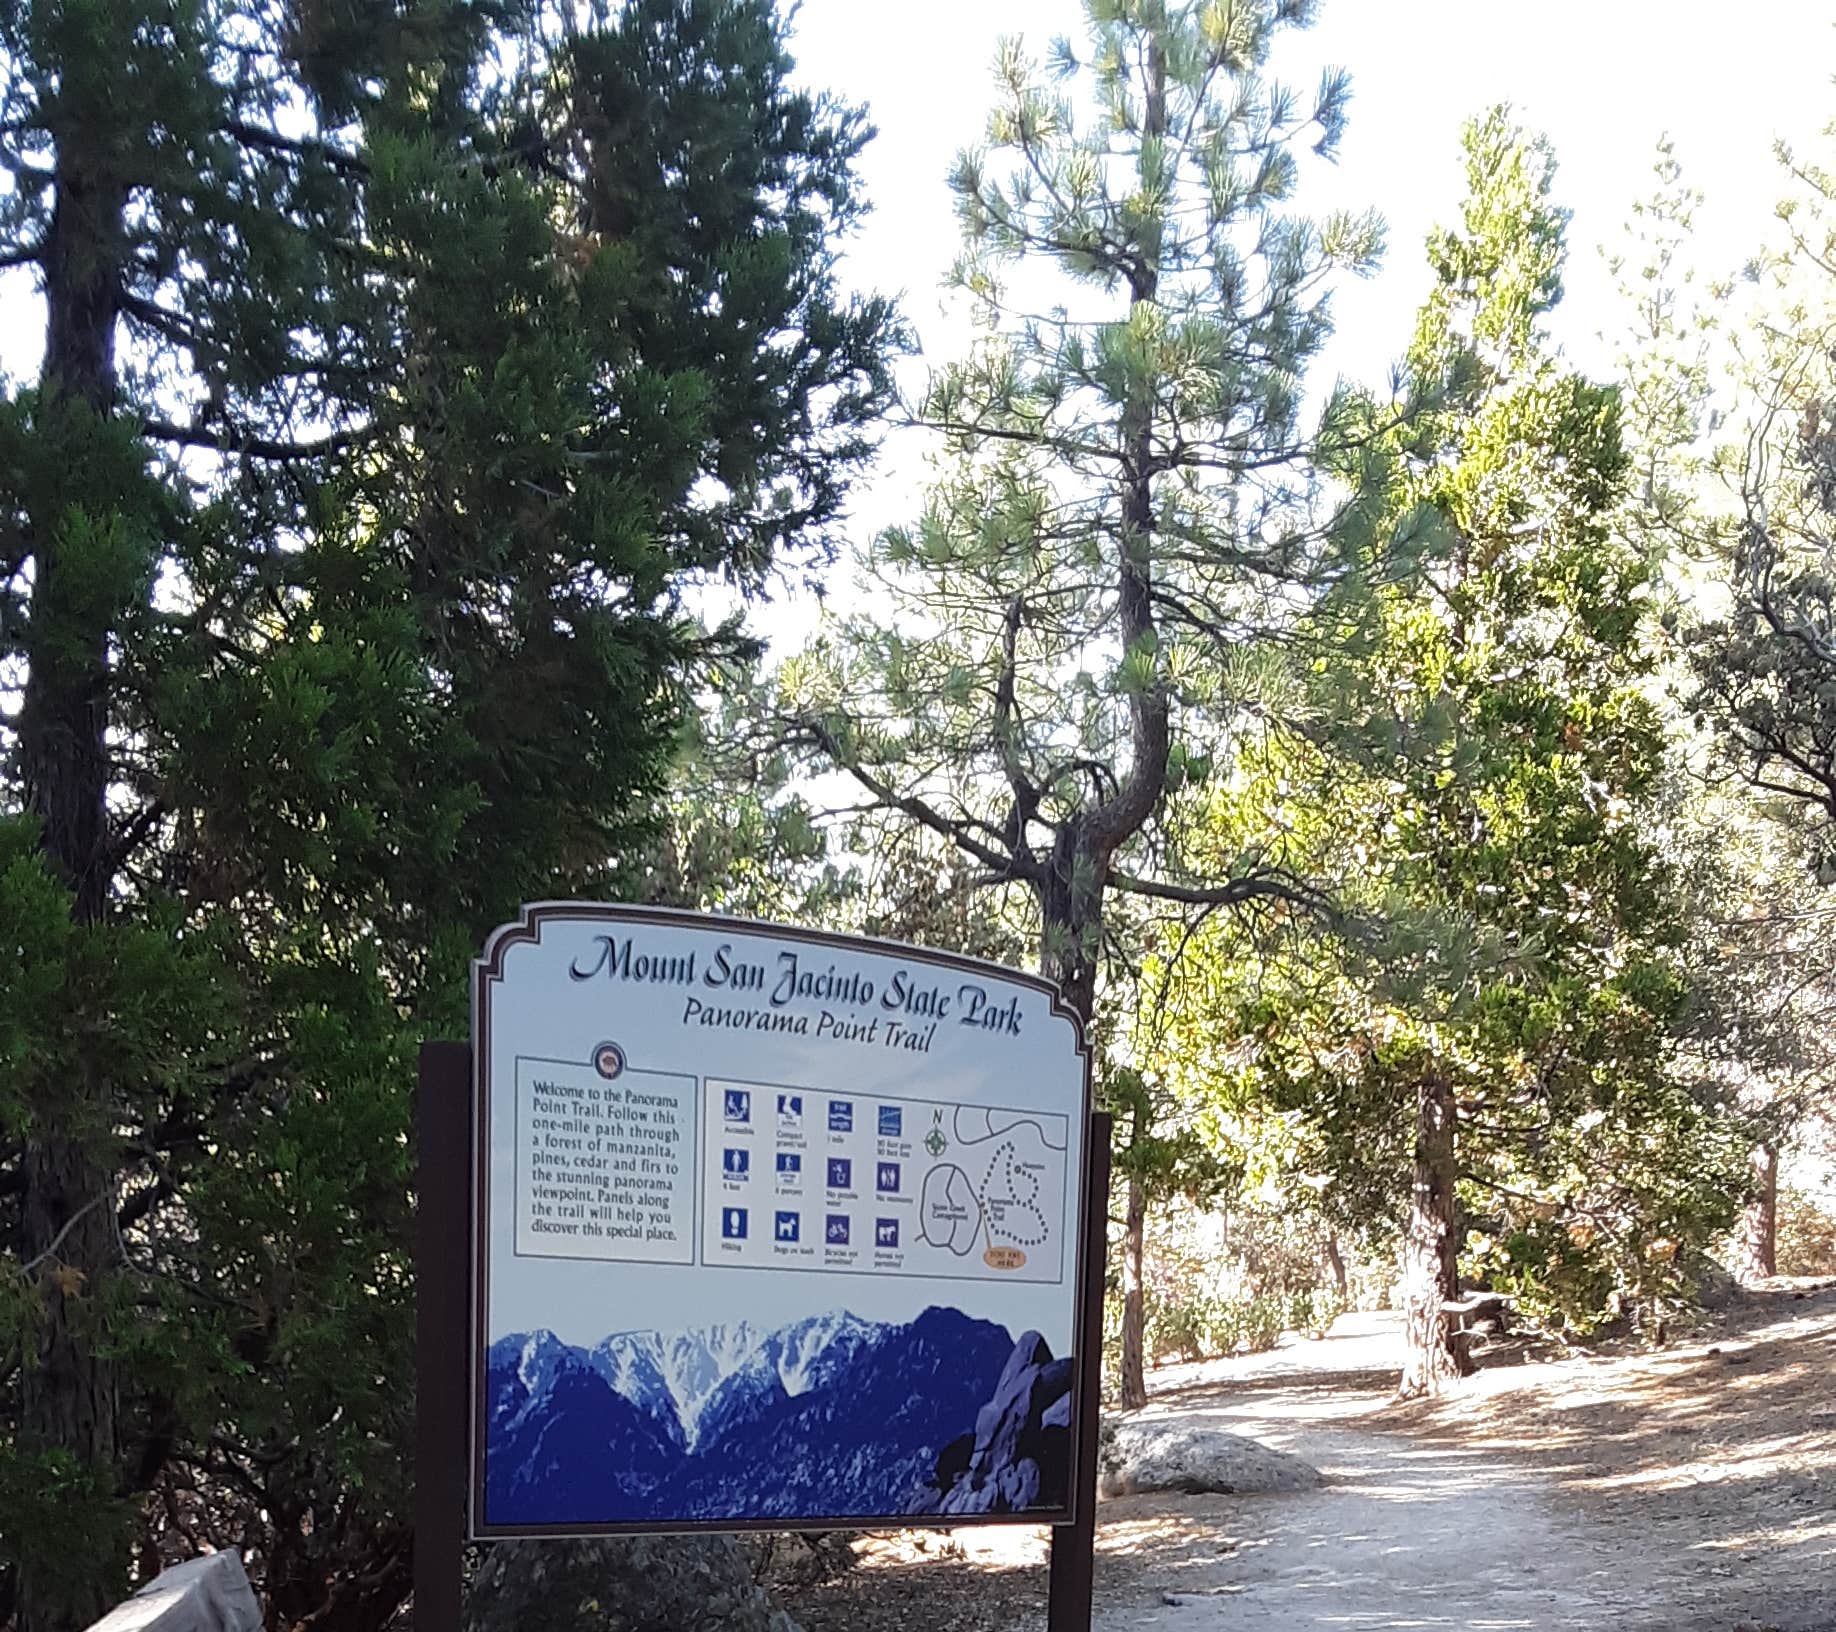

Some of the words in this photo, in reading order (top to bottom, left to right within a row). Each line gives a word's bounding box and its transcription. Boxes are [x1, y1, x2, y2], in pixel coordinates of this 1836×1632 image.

[569, 935, 696, 985] Mount
[704, 944, 765, 990] San
[769, 952, 875, 1008] Jacinto
[880, 970, 950, 1020] State
[957, 984, 1023, 1036] Park
[683, 996, 808, 1036] Panorama
[816, 1010, 878, 1043] Point
[885, 1021, 937, 1052] Trail
[533, 1080, 584, 1099] Welcome
[588, 1088, 600, 1099] to
[604, 1089, 622, 1103] the
[625, 1092, 678, 1108] Panorama
[533, 1098, 566, 1114] Point
[572, 1101, 603, 1118] Trail.
[608, 1106, 647, 1122] Follow
[653, 1111, 675, 1124] this
[933, 1109, 943, 1124] N
[533, 1118, 590, 1134] one-mile
[596, 1123, 623, 1139] path
[630, 1125, 680, 1143] through
[533, 1137, 539, 1146] a
[545, 1134, 582, 1150] forest
[588, 1138, 602, 1152] of
[607, 1141, 675, 1159] manzanita,
[533, 1152, 570, 1168] pines,
[574, 1155, 608, 1169] cedar
[614, 1158, 636, 1172] and
[641, 1159, 661, 1173] firs
[666, 1162, 678, 1175] to
[533, 1168, 551, 1182] the
[557, 1172, 609, 1188] stunning
[614, 1177, 673, 1191] panorama
[532, 1187, 594, 1203] viewpoint.
[598, 1189, 634, 1205] Panels
[637, 1193, 669, 1210] along
[532, 1203, 552, 1216] the
[558, 1204, 584, 1218] trail
[590, 1206, 612, 1220] will
[617, 1209, 644, 1224] help
[649, 1212, 671, 1224] you
[532, 1219, 578, 1235] discover
[583, 1223, 602, 1236] this
[606, 1225, 642, 1239] special
[646, 1228, 677, 1241] place.
